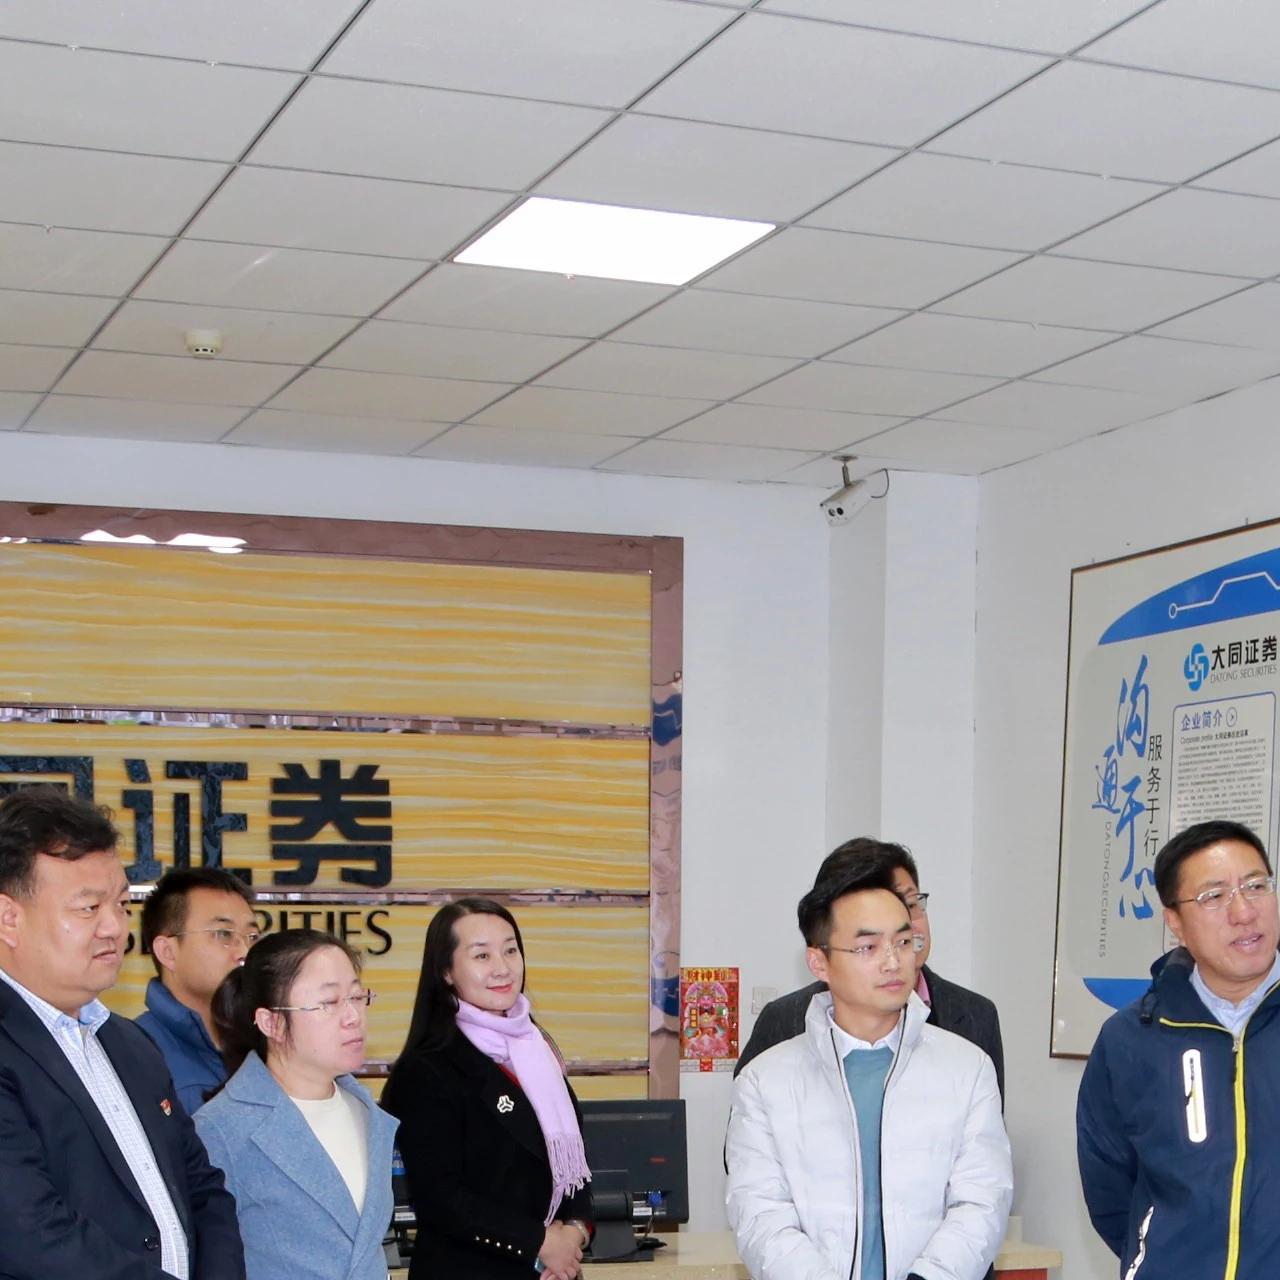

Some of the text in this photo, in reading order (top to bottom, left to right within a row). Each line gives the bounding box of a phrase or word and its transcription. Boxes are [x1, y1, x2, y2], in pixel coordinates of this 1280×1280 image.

[1211, 635, 1278, 671] 大同证券
[1210, 664, 1278, 684] DATONG SECURITIES
[1181, 708, 1222, 731] 企业简介
